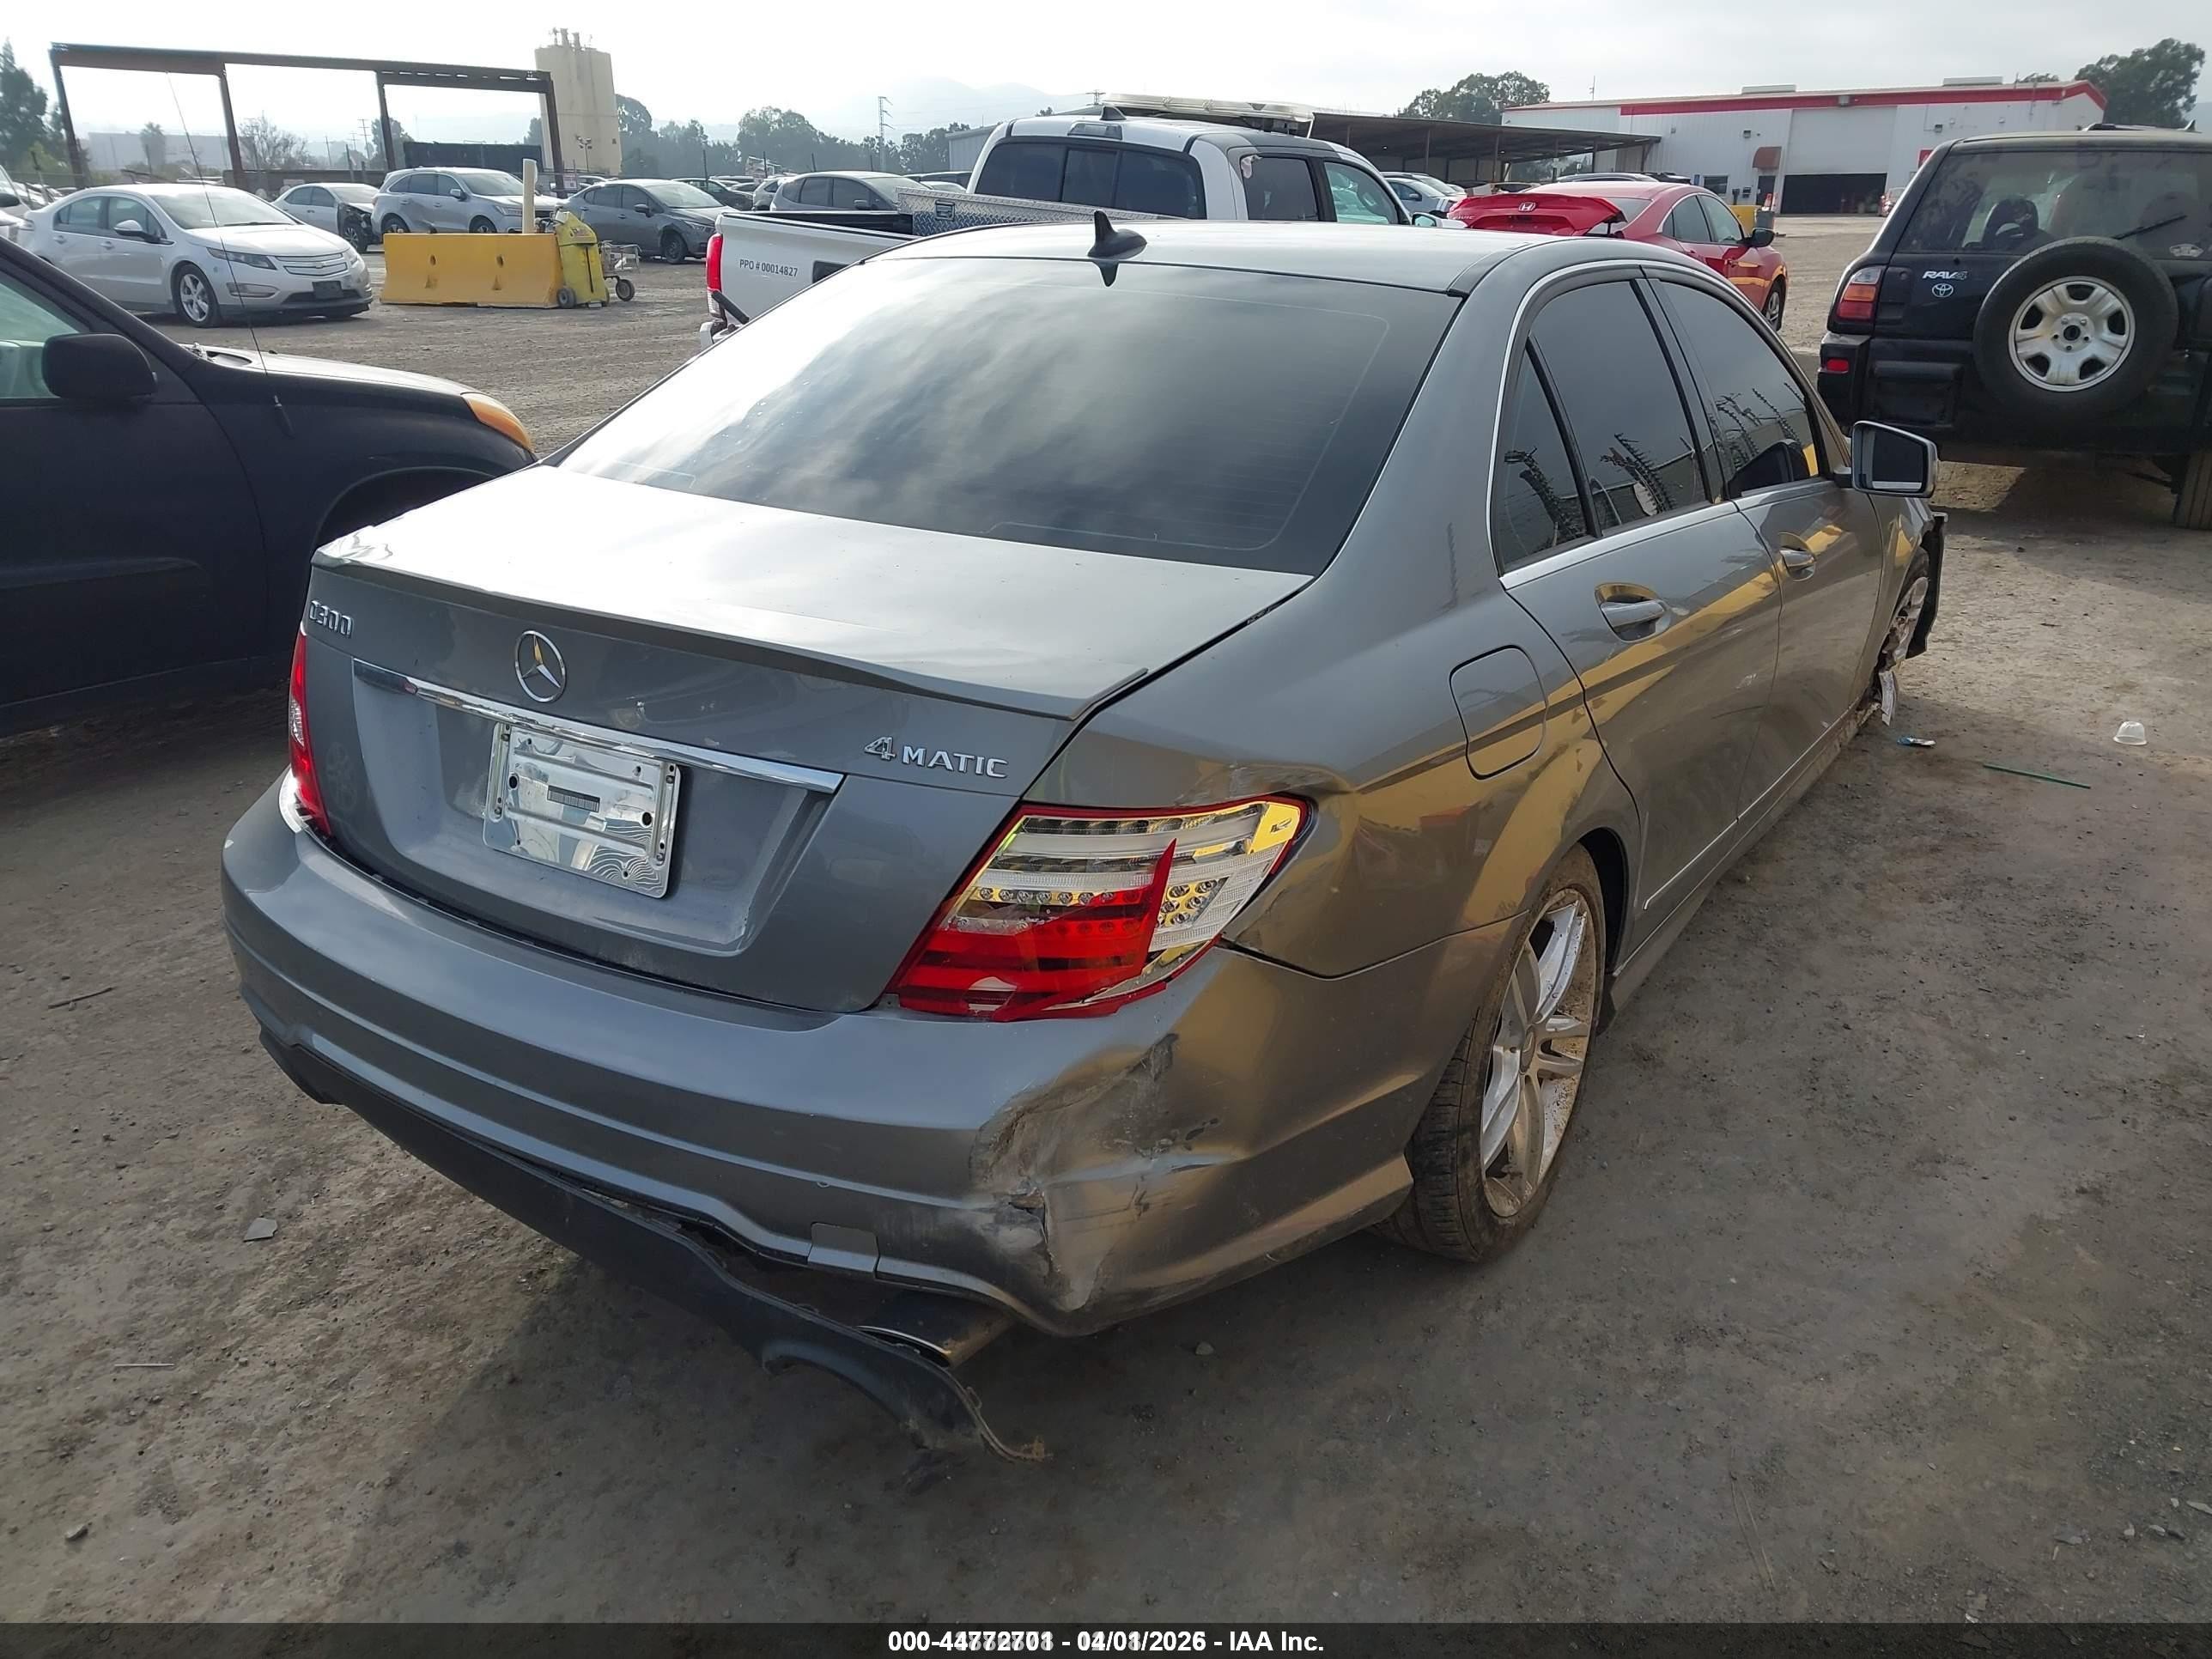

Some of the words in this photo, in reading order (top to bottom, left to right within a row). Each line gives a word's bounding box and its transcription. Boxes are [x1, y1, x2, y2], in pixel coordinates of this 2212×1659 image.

[739, 258, 754, 270] PPO
[756, 261, 761, 270] #
[761, 262, 798, 276] 00014827
[1922, 270, 1968, 280] RAV4
